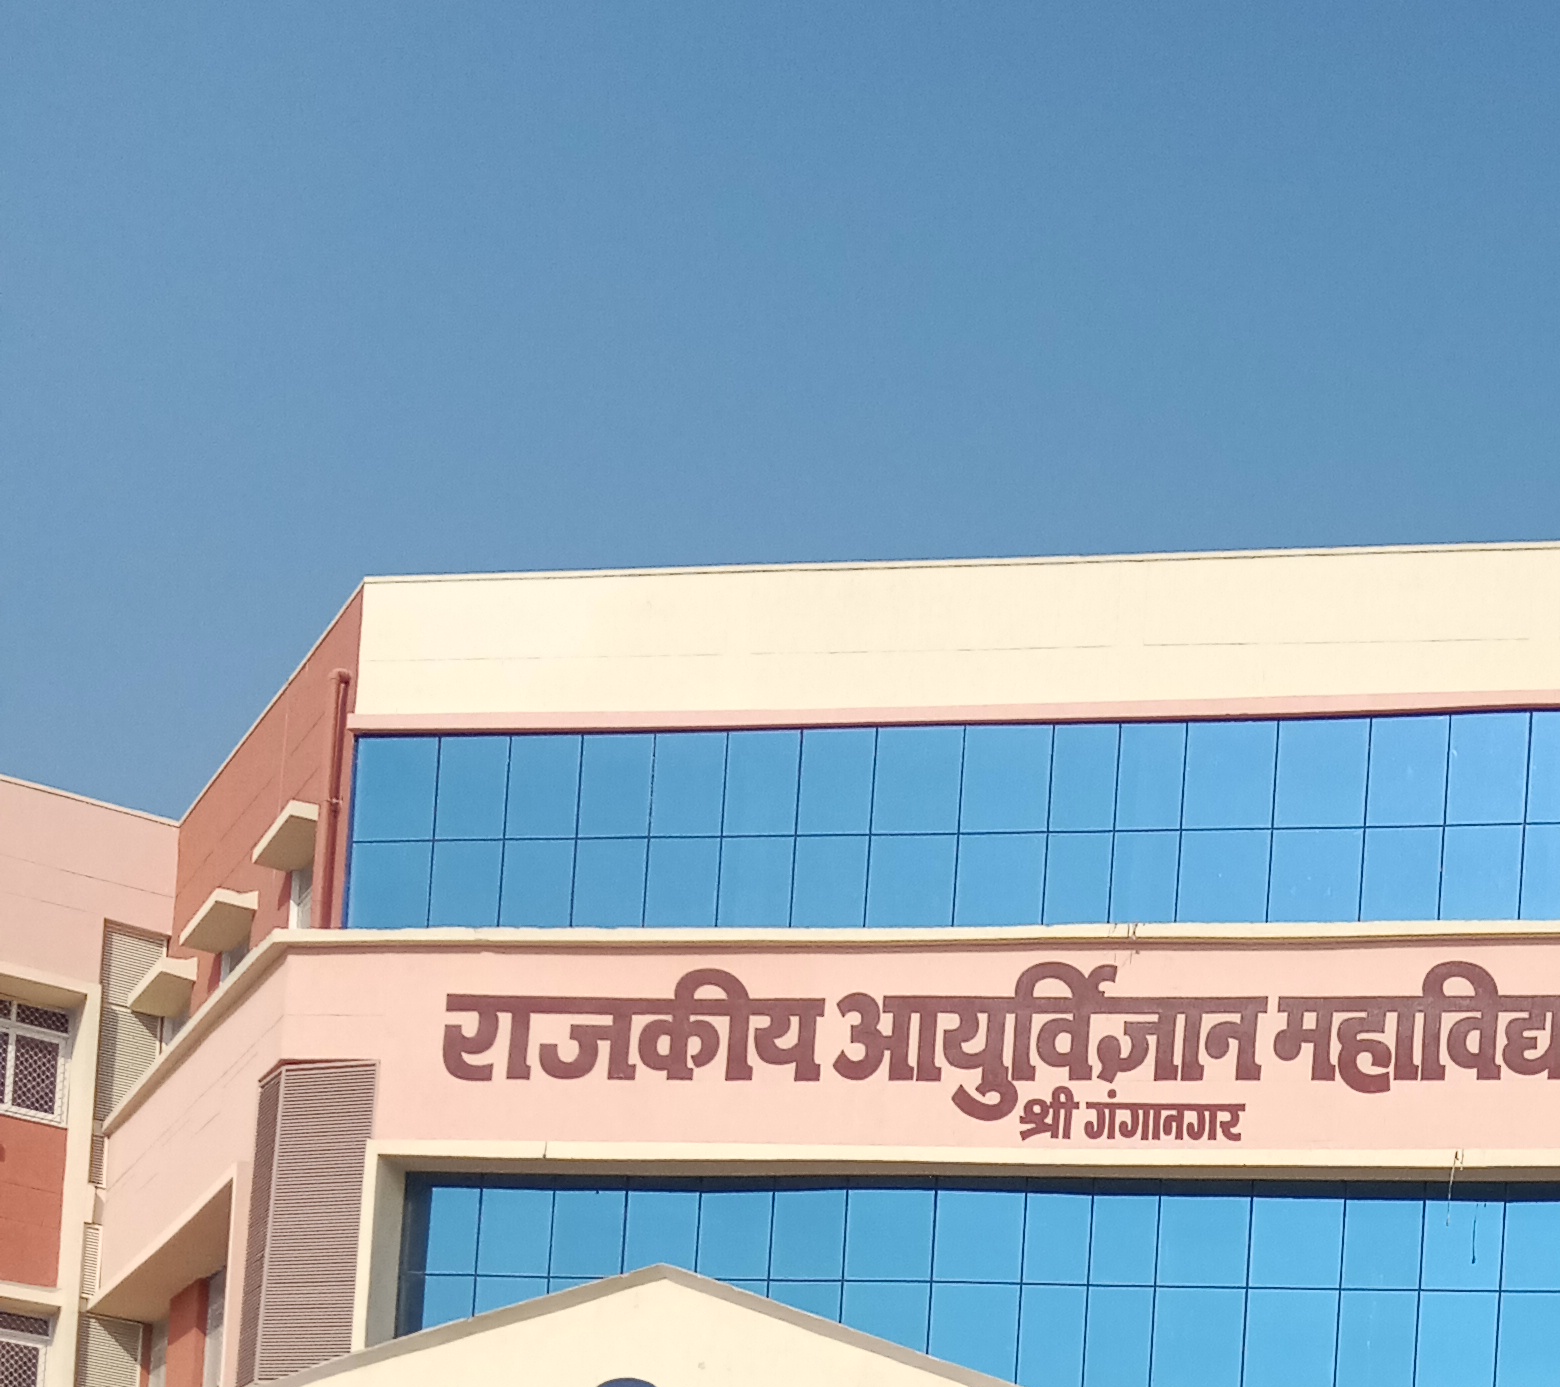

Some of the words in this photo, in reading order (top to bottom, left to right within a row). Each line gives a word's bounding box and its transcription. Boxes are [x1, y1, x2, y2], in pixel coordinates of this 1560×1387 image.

[442, 968, 826, 1082] राजकीय
[1019, 1085, 1080, 1141] श्री
[1083, 1088, 1246, 1142] गंगानगर
